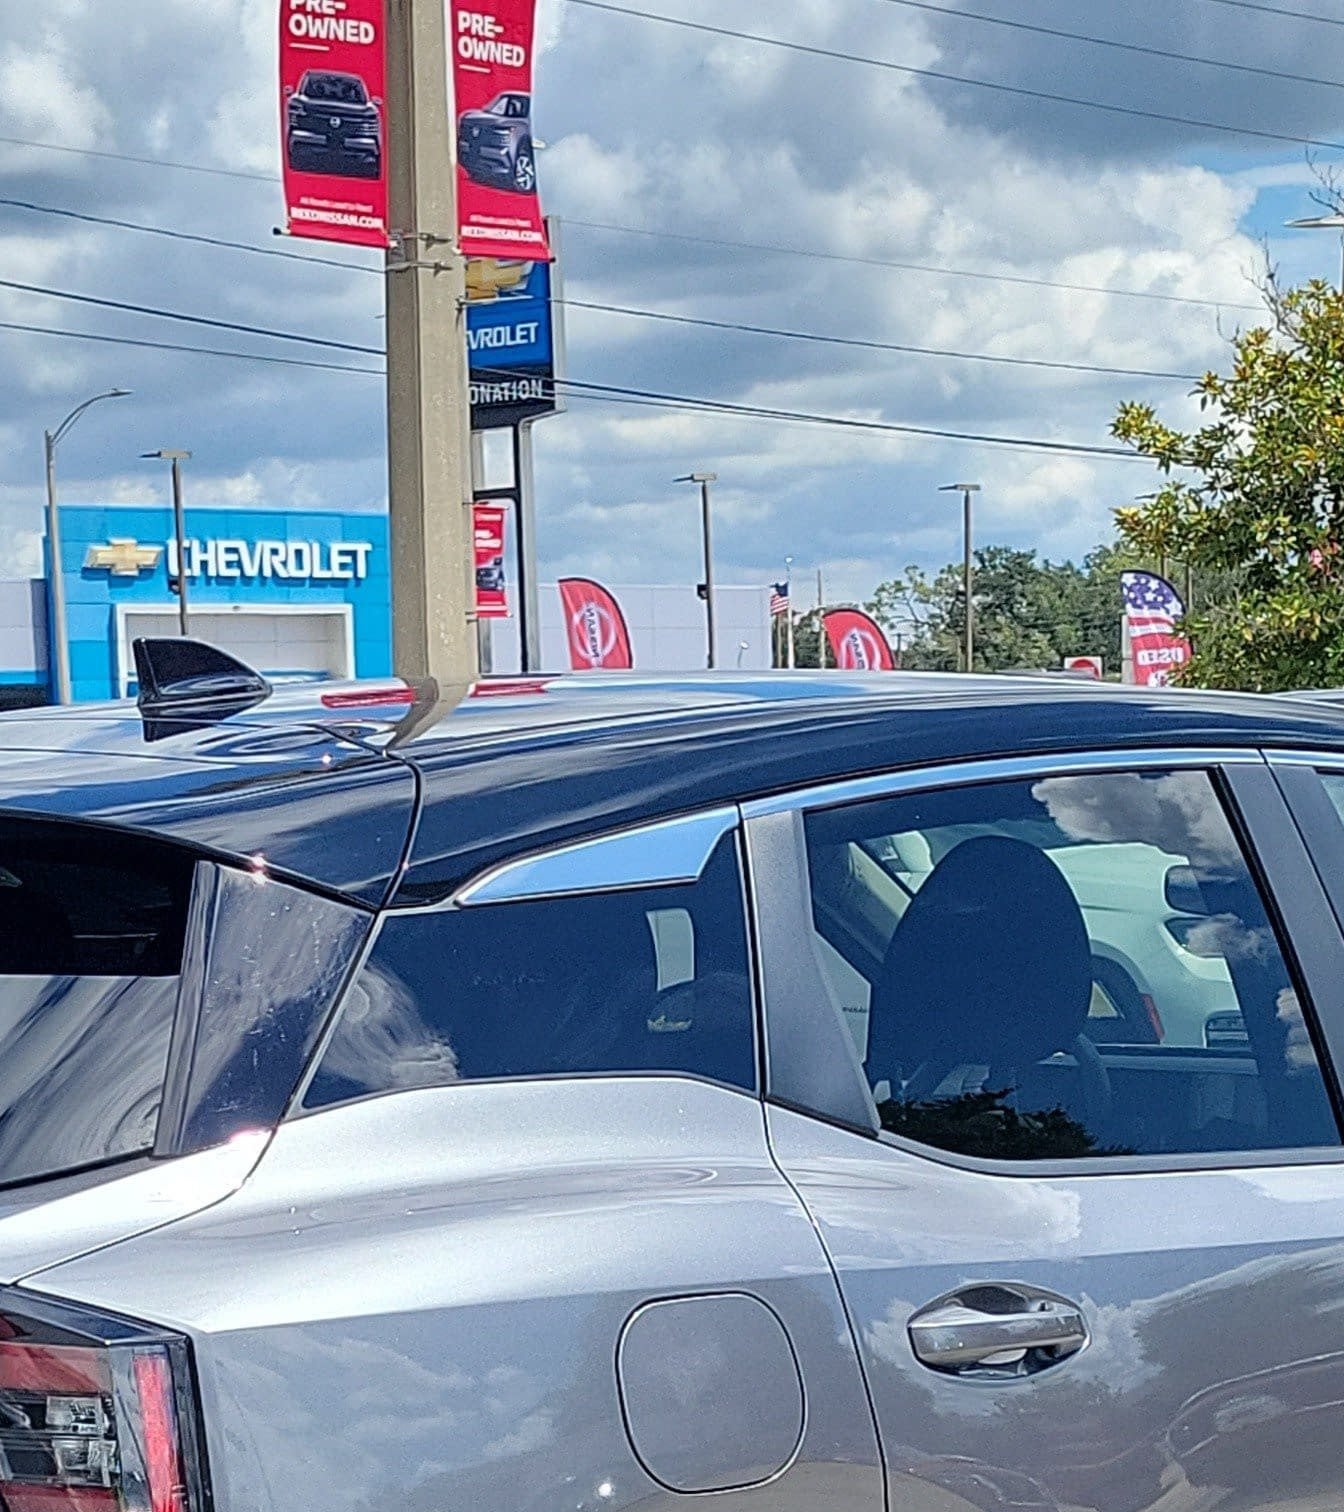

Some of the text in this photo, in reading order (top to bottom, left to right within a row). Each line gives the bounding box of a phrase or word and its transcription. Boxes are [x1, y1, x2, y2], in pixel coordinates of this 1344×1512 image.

[289, 13, 375, 44] OWNED
[458, 10, 504, 38] PRE-
[458, 35, 525, 67] OWNED
[465, 322, 539, 350] VROLET
[468, 379, 542, 405] ONATION
[167, 538, 372, 579] CHEVROLET
